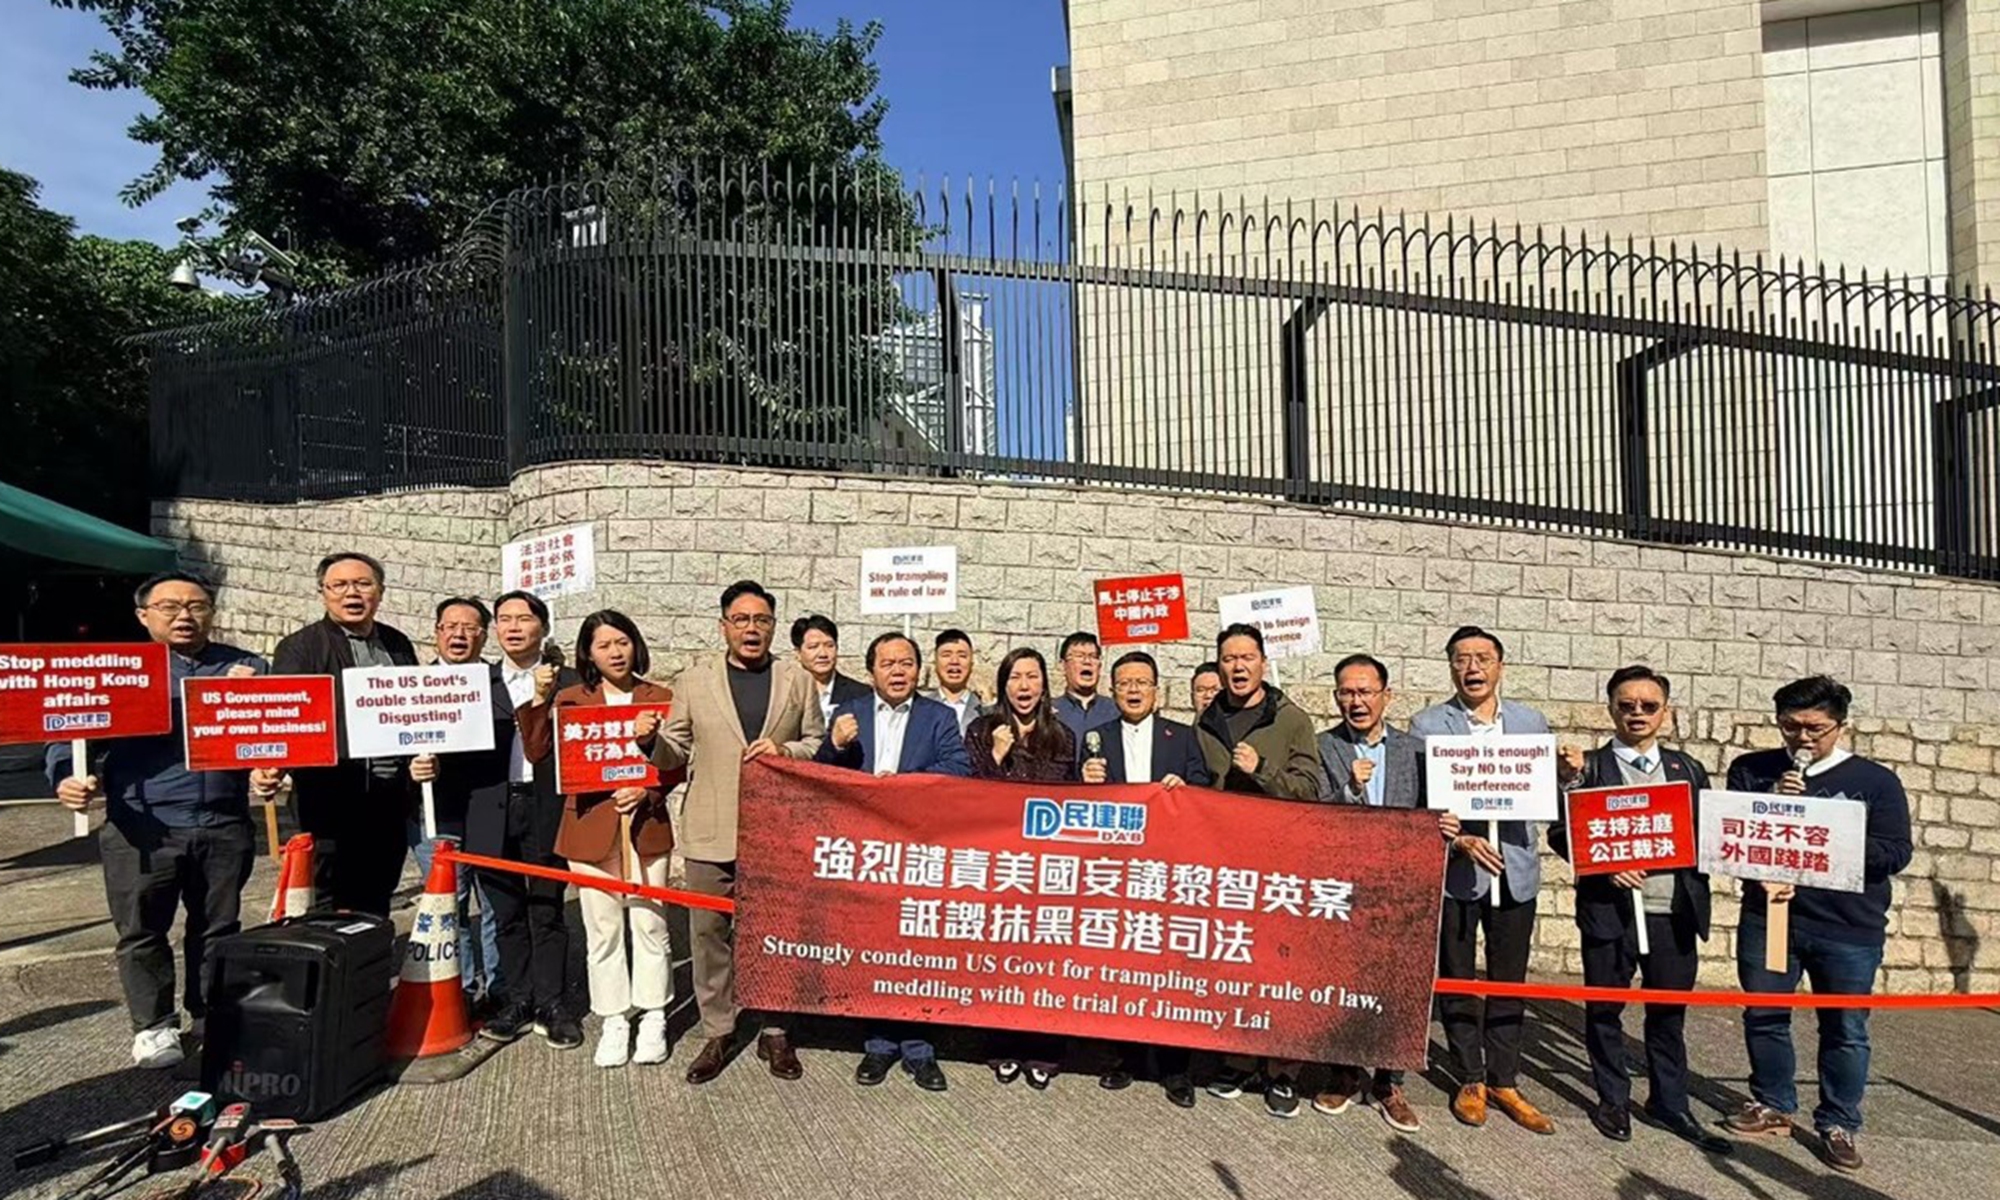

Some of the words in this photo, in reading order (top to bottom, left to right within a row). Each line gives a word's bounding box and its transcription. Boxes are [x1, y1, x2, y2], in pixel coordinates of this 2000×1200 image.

[868, 572, 893, 584] Stop
[896, 570, 948, 582] trampling
[870, 587, 885, 597] HK
[888, 587, 910, 597] rule
[911, 586, 923, 596] of
[926, 586, 946, 596] law
[1098, 585, 1180, 605] 馬上停止干涉
[1263, 621, 1274, 630] to
[1275, 616, 1310, 628] foreign
[0, 655, 45, 672] Stop
[51, 653, 142, 669] meddling
[43, 674, 96, 689] Hong
[101, 672, 149, 688] Kong
[367, 677, 394, 689] The
[398, 676, 418, 688] US
[43, 693, 110, 708] affairs
[202, 692, 221, 704] US
[224, 690, 312, 704] Government,
[356, 694, 406, 707] double
[411, 691, 481, 705] standard!
[216, 707, 262, 721] please
[265, 706, 299, 718] mind
[379, 709, 462, 726] Disgusting!
[193, 724, 225, 738] your
[228, 724, 258, 734] own
[262, 721, 326, 734] business!
[1432, 746, 1479, 759] Enough
[1483, 746, 1494, 757] is
[1498, 746, 1549, 759] enough!
[1450, 763, 1474, 776] Say
[1478, 763, 1496, 775] NO
[1499, 763, 1512, 775] to
[1515, 763, 1532, 775] US
[1453, 780, 1530, 791] interference
[1064, 802, 1144, 831] 民建聯
[1587, 812, 1673, 840] 支持法庭
[1721, 817, 1830, 847] 司法不容
[1589, 836, 1676, 863] 公正裁決
[1720, 841, 1830, 873] 外國踐踏
[812, 836, 1353, 921] 強烈譴責美國妄議黎智英案
[763, 935, 854, 966] Strongly
[860, 949, 958, 971] condemn
[966, 954, 997, 973] US
[1003, 956, 1055, 976] Govt
[1062, 959, 1094, 980] for
[1099, 964, 1208, 997] trampling
[1214, 979, 1252, 997] our
[1258, 980, 1304, 1002] rule
[1310, 985, 1335, 1005] of
[1339, 987, 1383, 1014] law,
[873, 977, 973, 1005] meddling
[980, 984, 1025, 1006] with
[1032, 988, 1066, 1009] the
[1072, 993, 1118, 1015] trial
[1124, 998, 1148, 1017] of
[1151, 999, 1227, 1030] Jimmy
[1233, 1007, 1271, 1031] Lai
